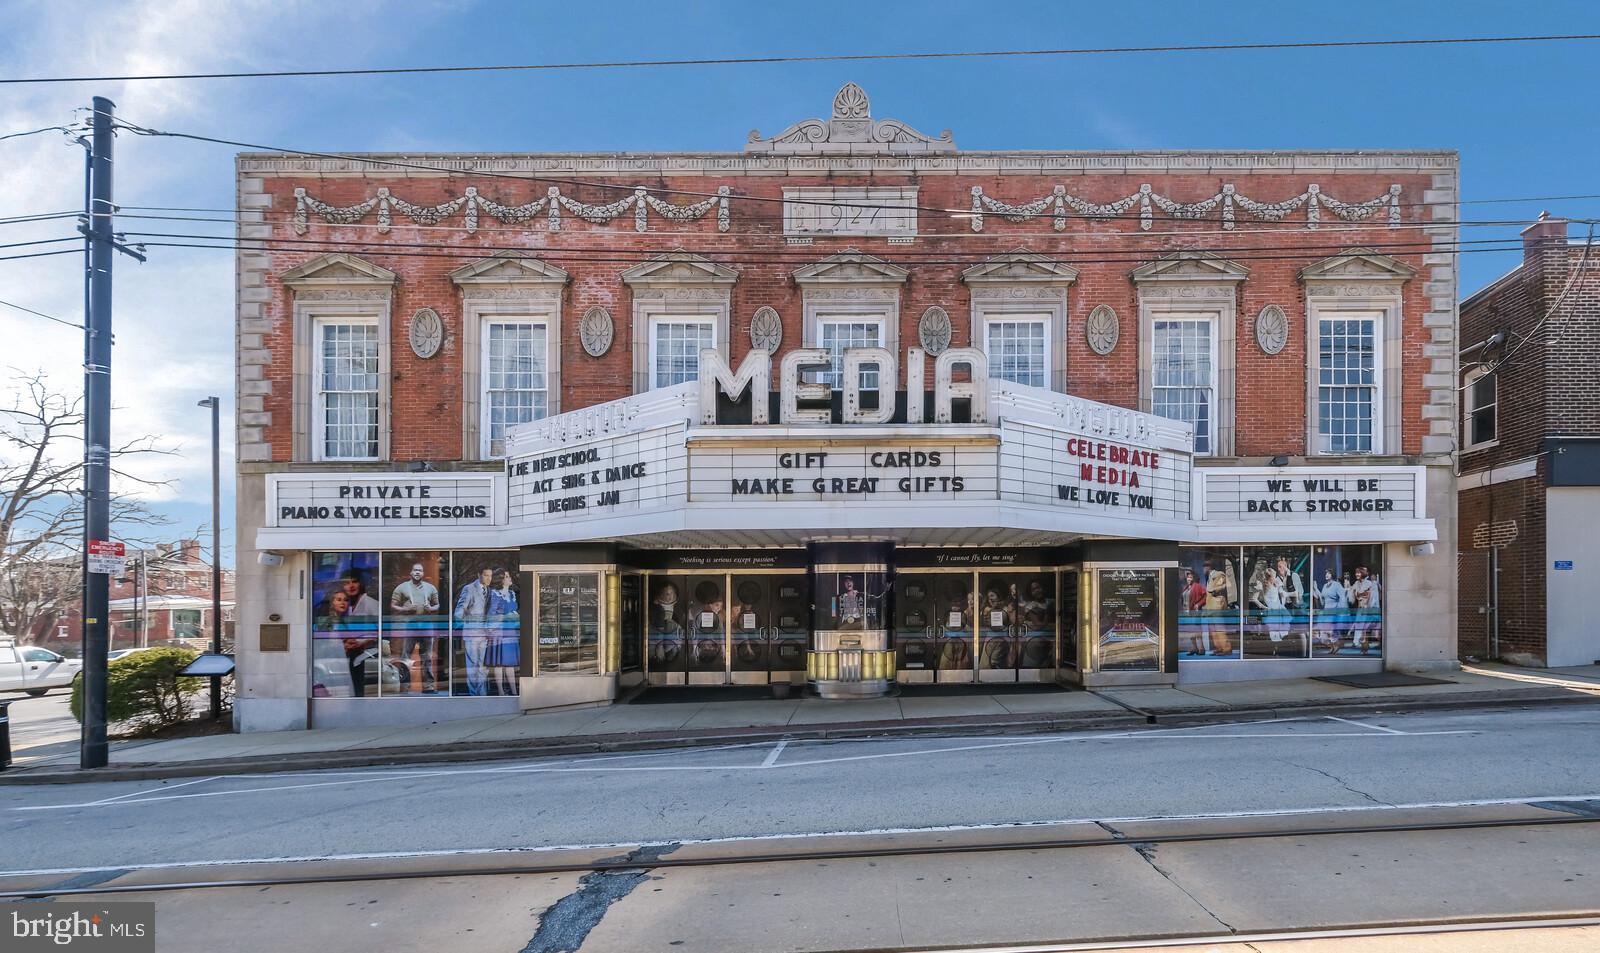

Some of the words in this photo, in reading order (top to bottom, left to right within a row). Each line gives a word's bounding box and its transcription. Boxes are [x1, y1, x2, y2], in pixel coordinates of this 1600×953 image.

[818, 205, 881, 226] 1927
[700, 347, 987, 424] MEDIA
[550, 403, 627, 442] MEDIA
[1065, 399, 1150, 441] MEDIA
[508, 458, 529, 478] THE
[532, 455, 557, 474] NEW
[558, 448, 601, 469] SCHOOL
[779, 453, 827, 468] GIFT
[871, 451, 941, 468] CARDS
[1067, 438, 1159, 470] CELEBRATE
[532, 478, 553, 494] ACT
[561, 472, 585, 490] SING
[591, 470, 600, 484] &
[605, 462, 646, 482] DANCE
[732, 478, 794, 495] MAKE
[812, 478, 879, 494] GREAT
[899, 477, 964, 492] GIFTS
[1081, 462, 1140, 488] MEDIA
[1268, 479, 1292, 493] WE
[1304, 479, 1343, 492] WILL
[1357, 479, 1378, 492] BE
[339, 485, 431, 499] PRIVATE
[547, 495, 586, 513] BEGINS
[597, 490, 620, 506] JAN
[1057, 485, 1079, 501] WE
[1087, 487, 1120, 506] LOVE
[1129, 493, 1153, 510] YOU
[281, 505, 330, 519] PIANO
[333, 506, 344, 519] &
[350, 505, 402, 519] VOICE
[409, 505, 486, 519] LESSONS
[1247, 499, 1293, 512] BACK
[1306, 498, 1393, 512] STRONGER
